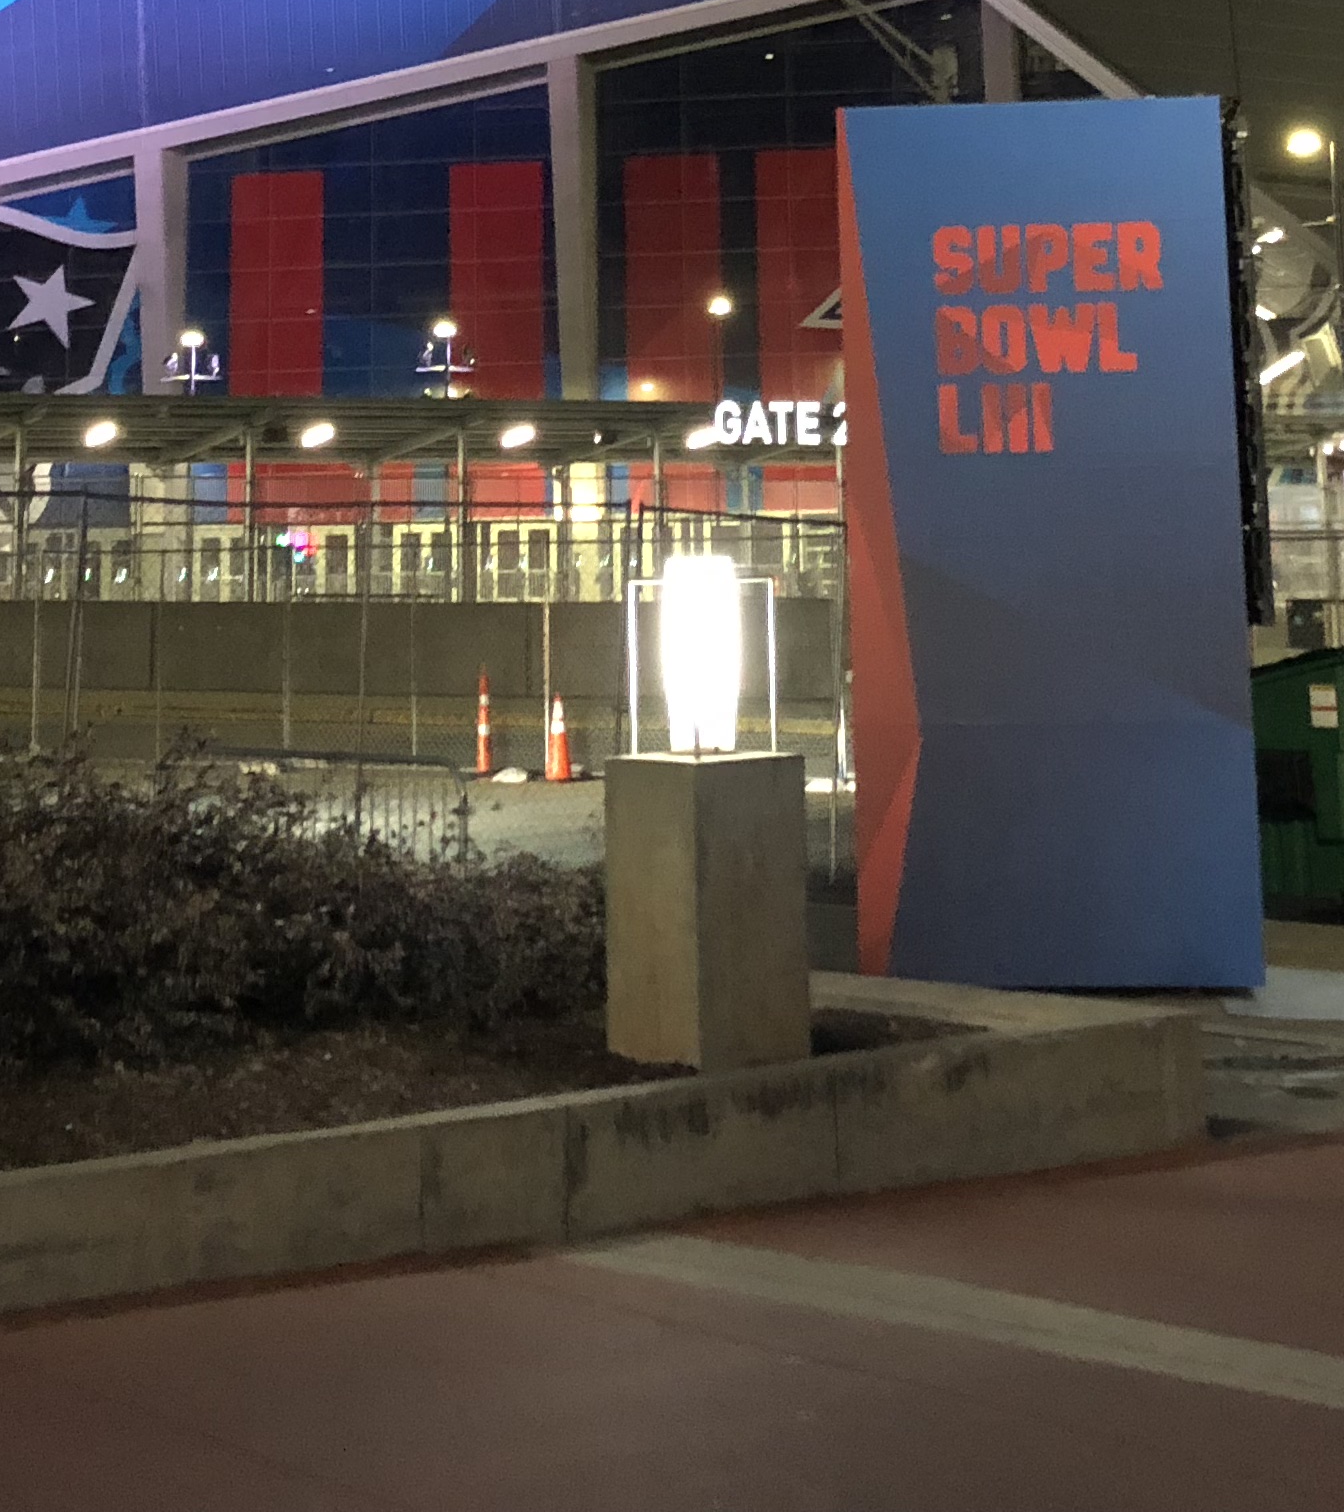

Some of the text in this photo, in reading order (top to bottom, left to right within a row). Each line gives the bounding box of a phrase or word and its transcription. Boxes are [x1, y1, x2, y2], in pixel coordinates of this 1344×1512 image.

[932, 221, 1164, 295] SUPER
[935, 301, 1138, 376] BOWL
[714, 399, 822, 446] GATE
[937, 382, 1056, 454] LIII
